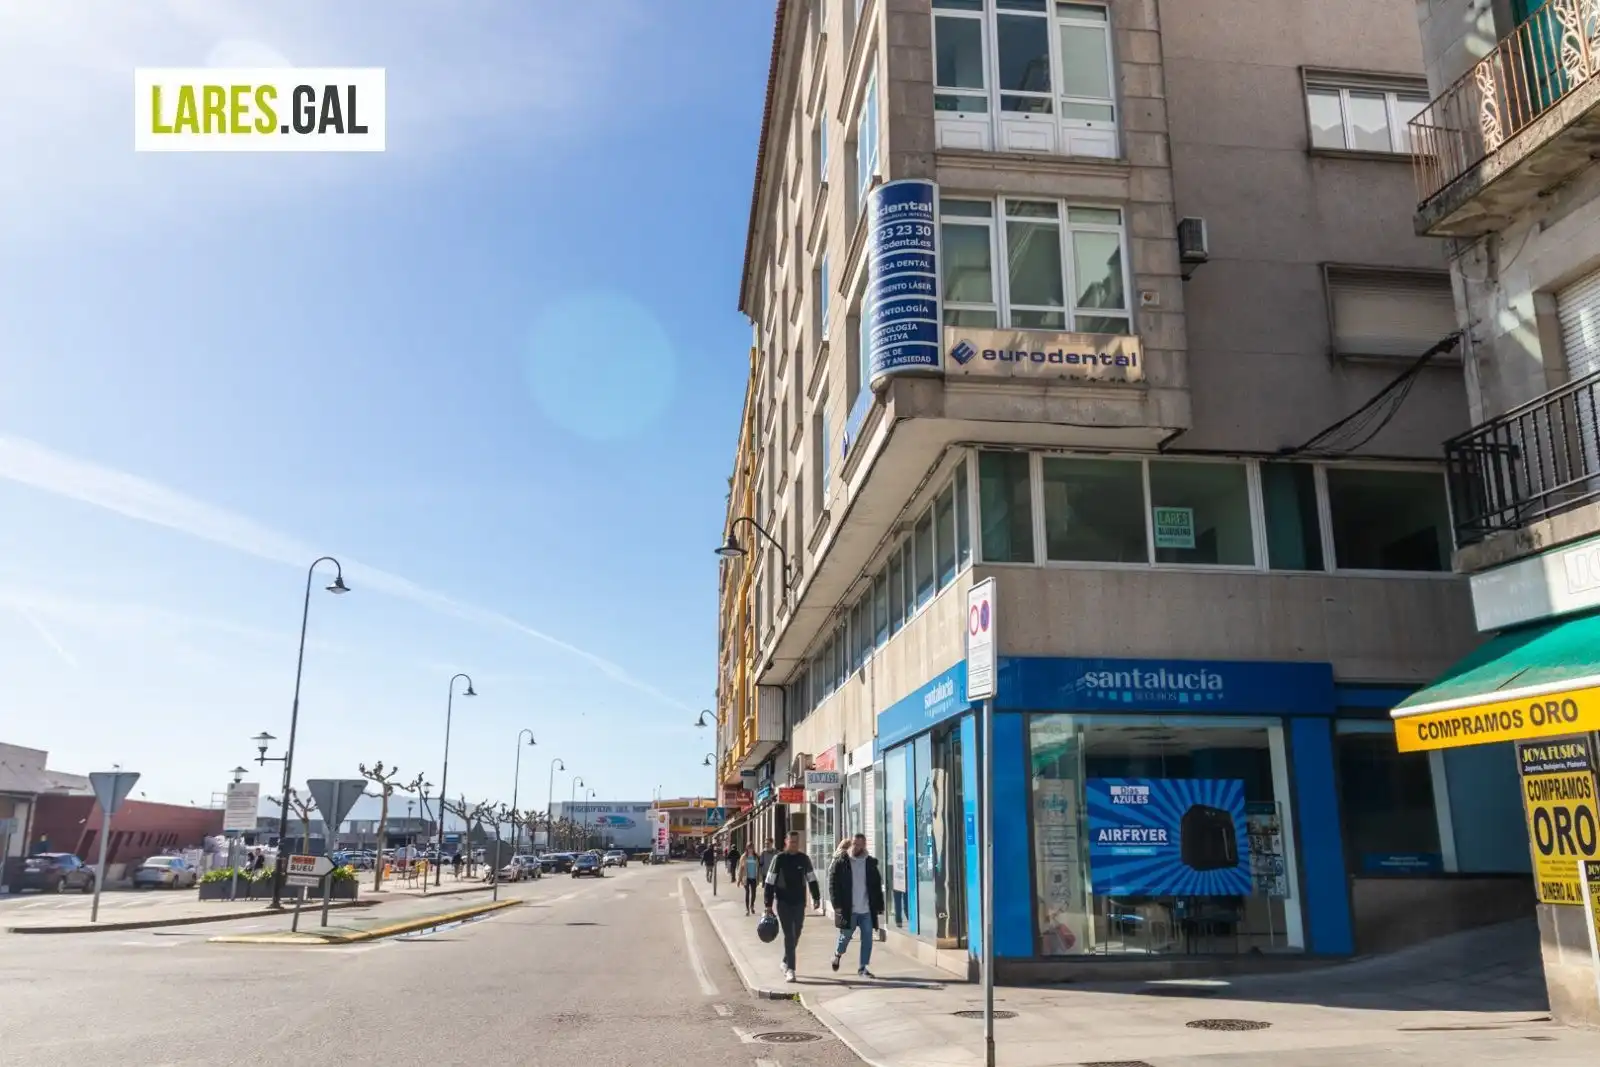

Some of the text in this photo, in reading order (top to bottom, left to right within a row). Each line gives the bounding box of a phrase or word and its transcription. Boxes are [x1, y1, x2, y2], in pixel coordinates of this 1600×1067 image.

[896, 225, 912, 236] 23
[916, 225, 931, 236] 30
[909, 281, 932, 290] LÁSER
[893, 355, 931, 365] ANSIEDAD
[982, 348, 1136, 367] eurodental
[1417, 698, 1579, 741] COMPRAMOS ORO
[1523, 744, 1586, 762] JOYA FUSION
[1527, 776, 1591, 801] COMPRAMOS
[1113, 795, 1149, 804] AZULES
[1098, 829, 1167, 841] AIRFRYER
[1533, 804, 1597, 856] ORO
[1541, 882, 1565, 900] DINERO
